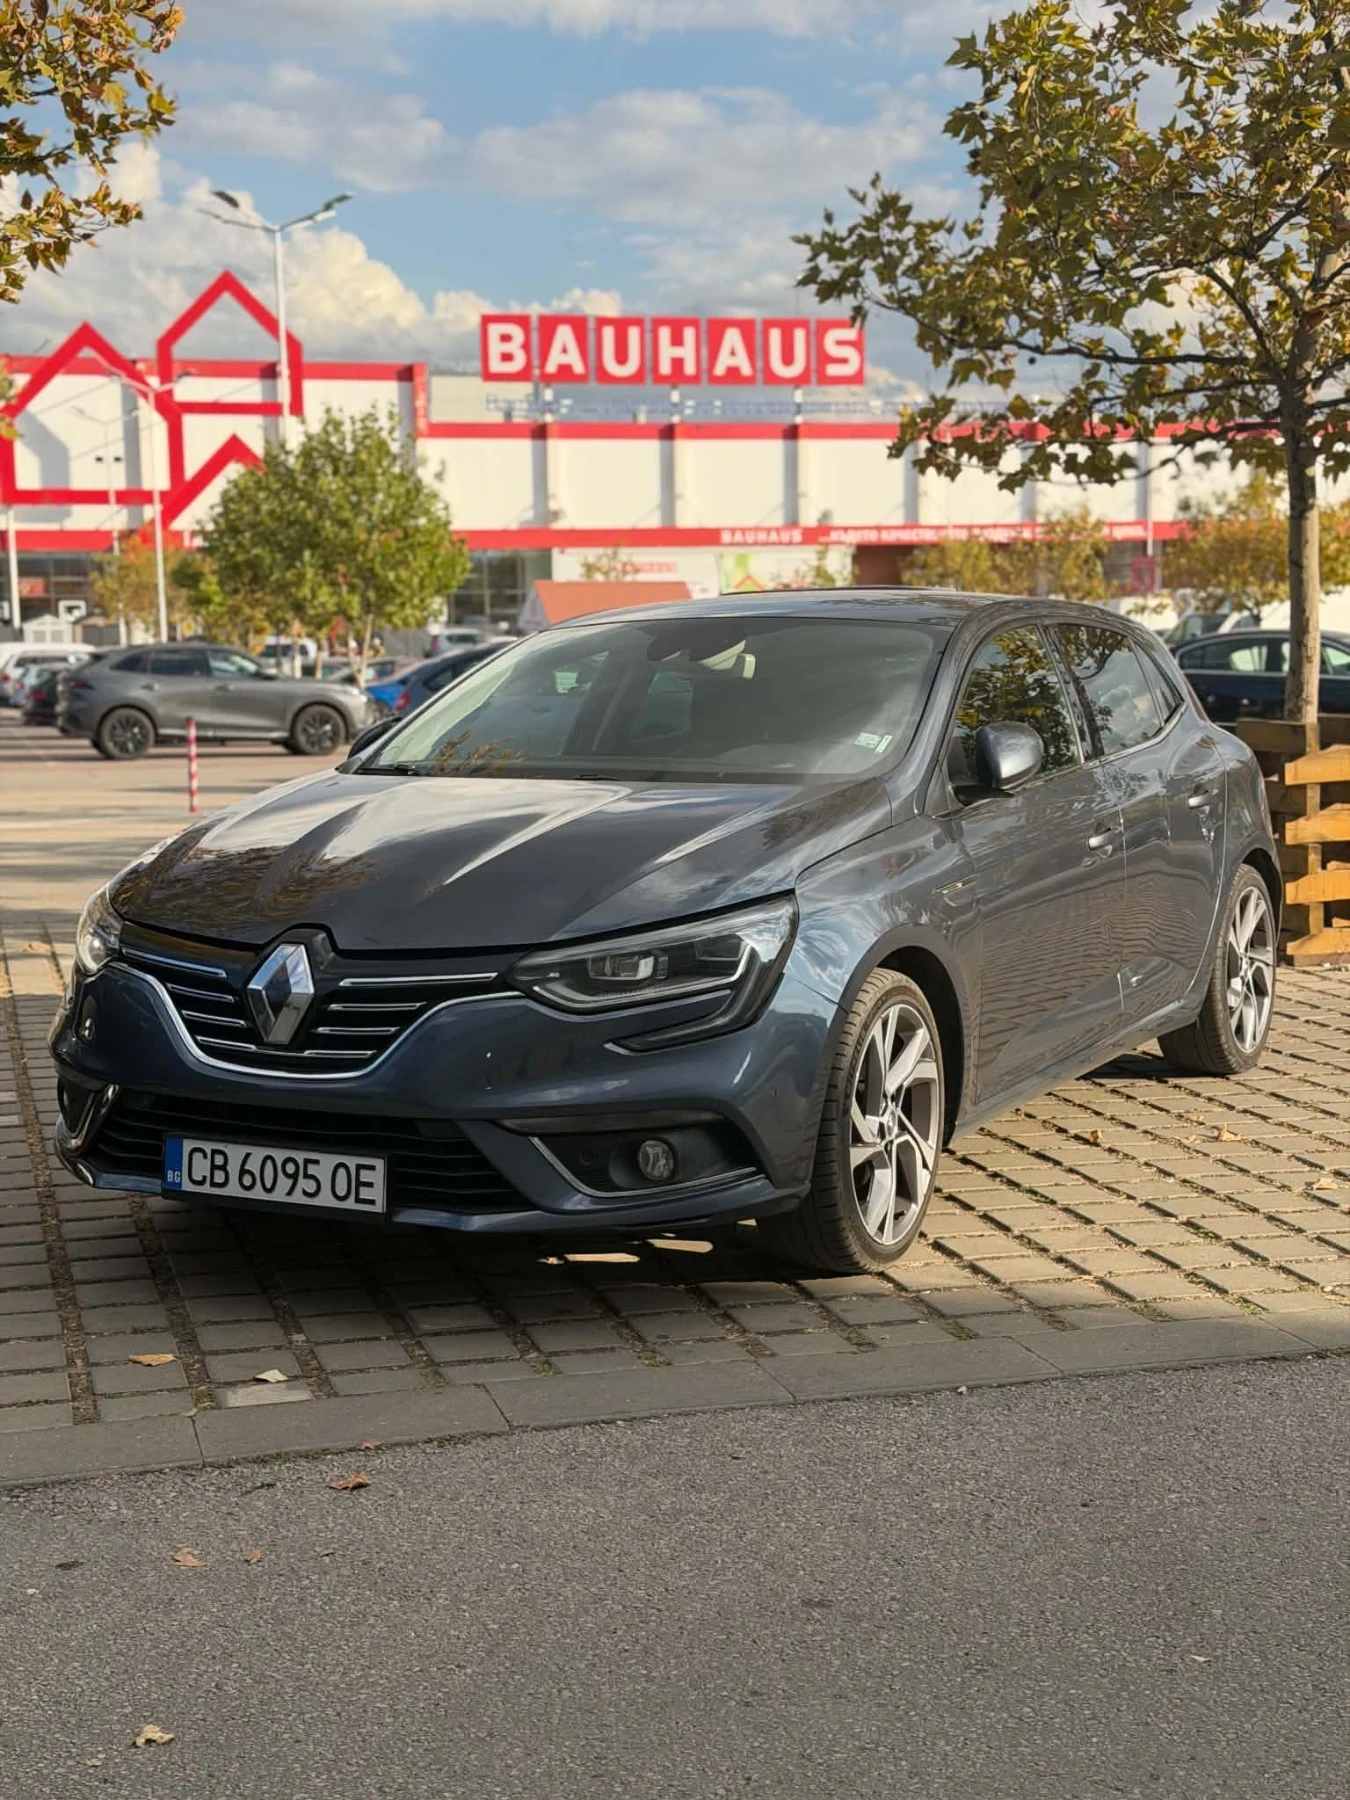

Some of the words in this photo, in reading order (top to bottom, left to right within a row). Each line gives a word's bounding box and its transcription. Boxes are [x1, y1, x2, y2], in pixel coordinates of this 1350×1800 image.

[486, 322, 861, 378] BAUHAUS
[721, 528, 802, 544] BAUHAUS
[167, 1170, 181, 1183] BG
[187, 1147, 230, 1188] CB
[238, 1152, 321, 1198] 6095
